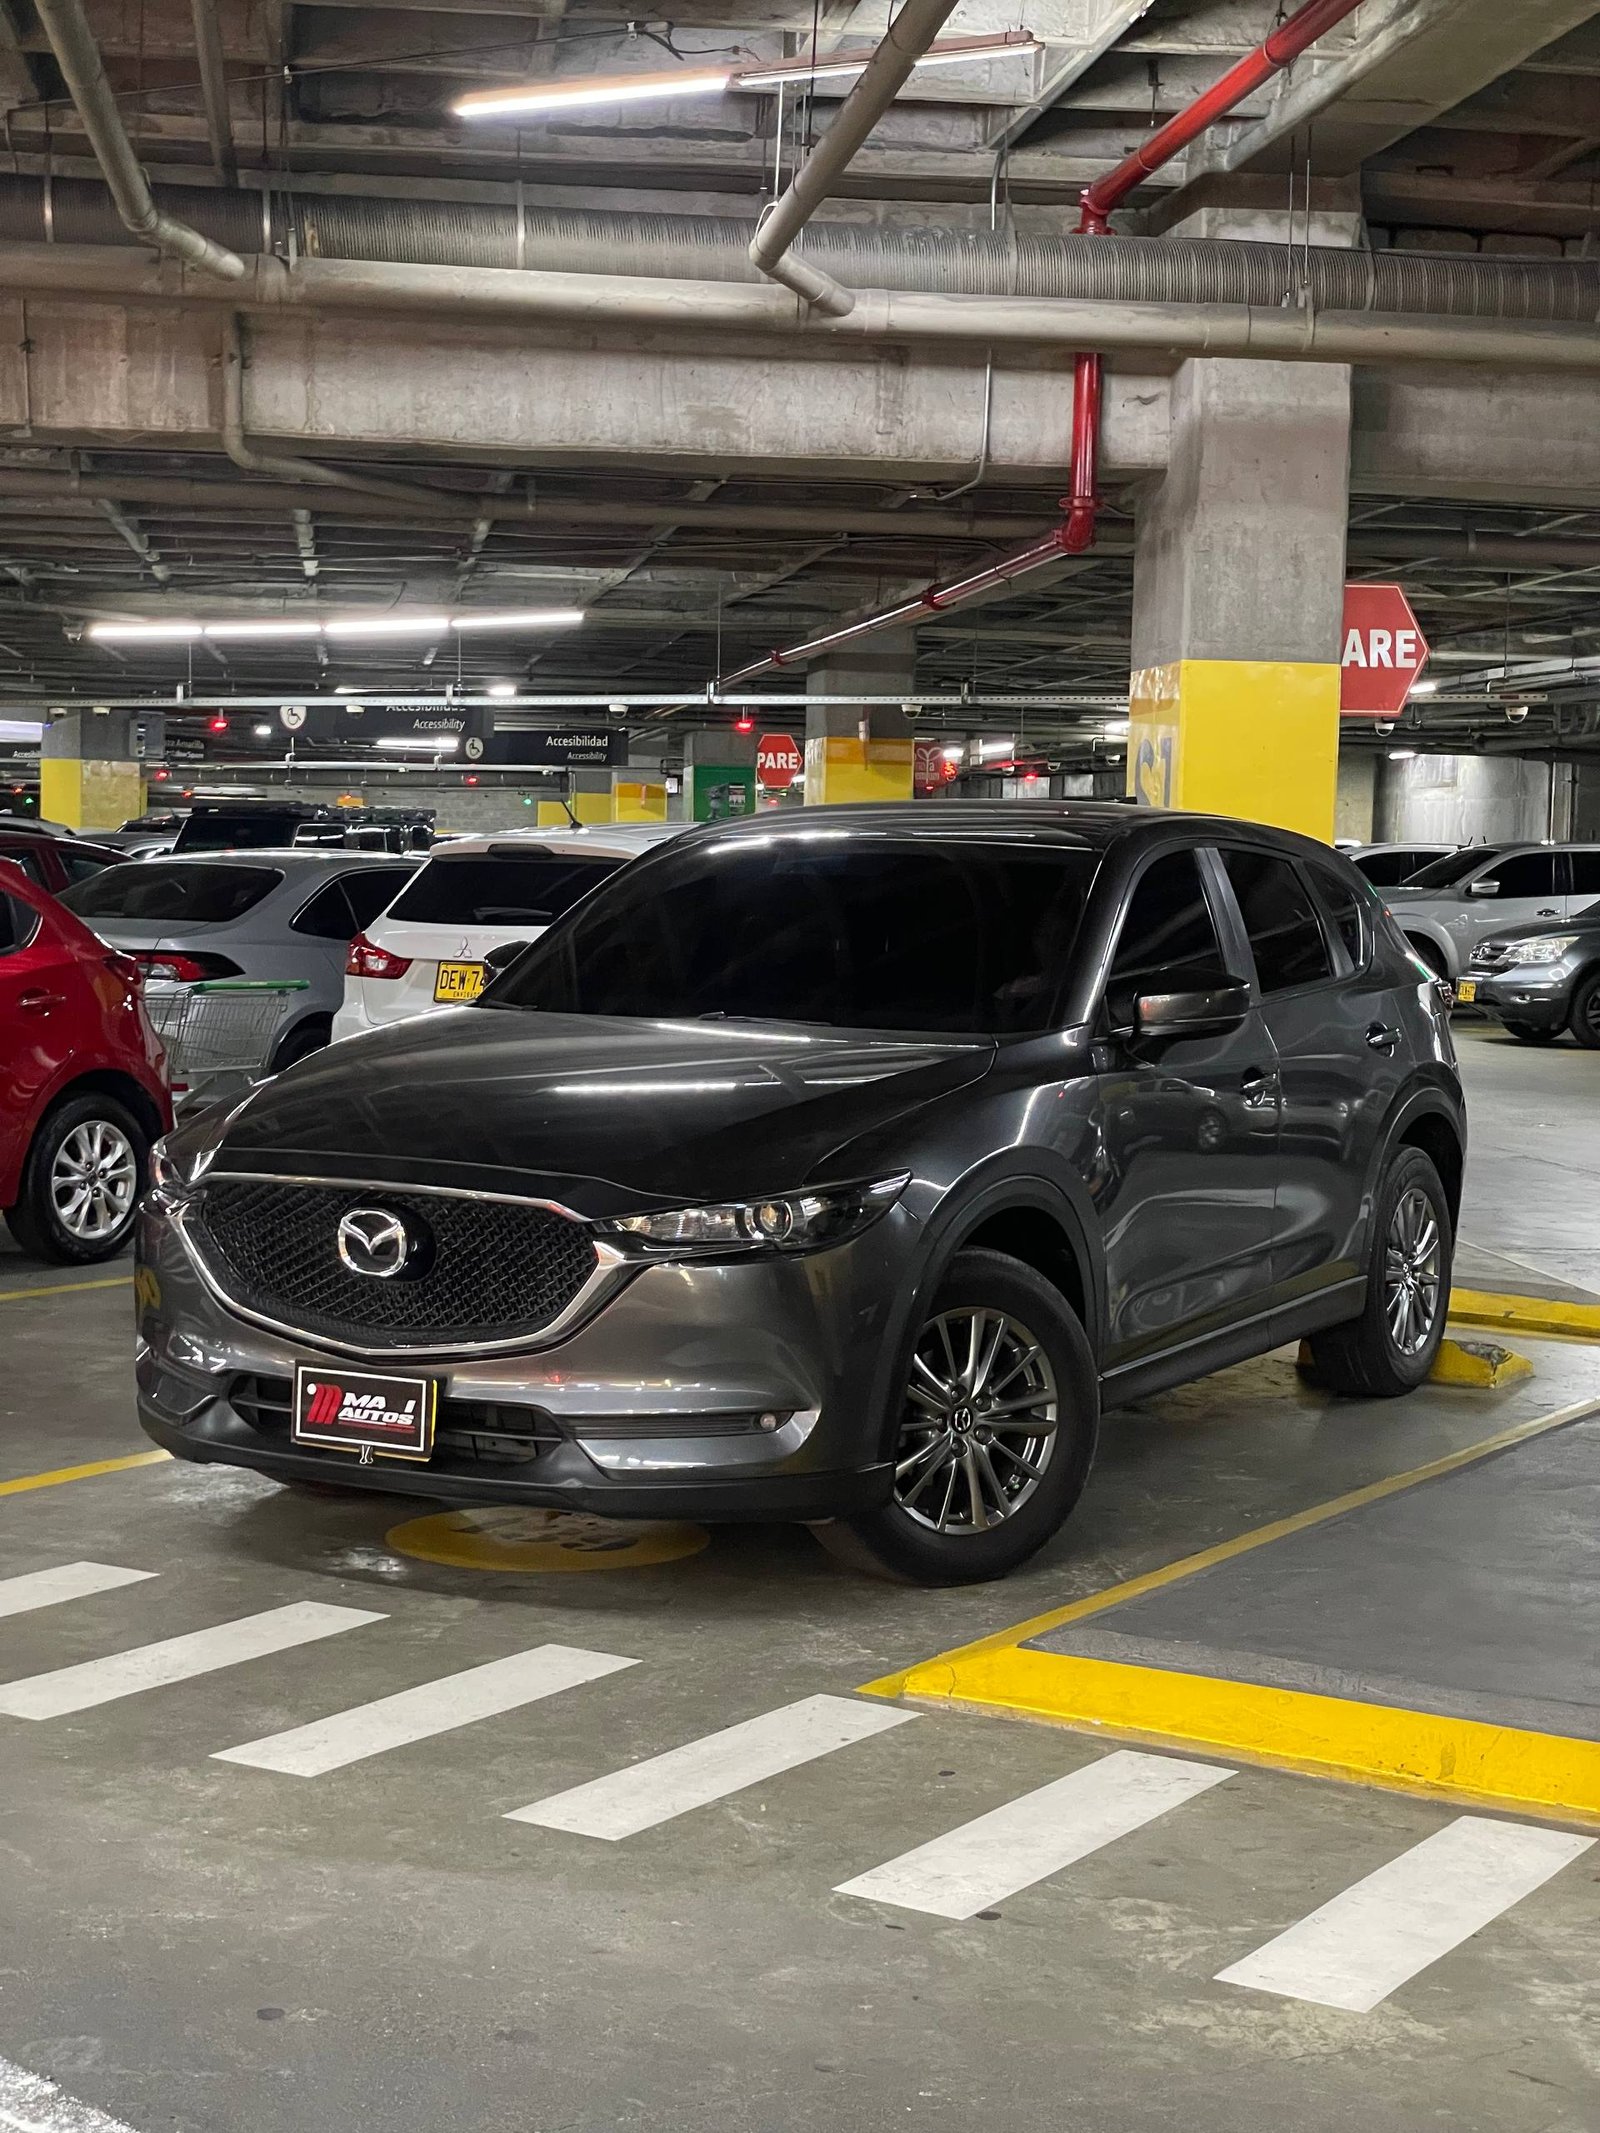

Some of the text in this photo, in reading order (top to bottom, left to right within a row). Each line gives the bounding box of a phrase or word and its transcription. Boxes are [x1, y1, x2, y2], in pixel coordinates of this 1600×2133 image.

[1341, 628, 1417, 668] ARE
[413, 718, 466, 732] Accessibility
[546, 735, 609, 747] Accesibilidad
[567, 751, 608, 762] Accessibility
[757, 752, 798, 769] PARE
[342, 1392, 387, 1410] MA
[337, 1407, 415, 1425] AUTOS
